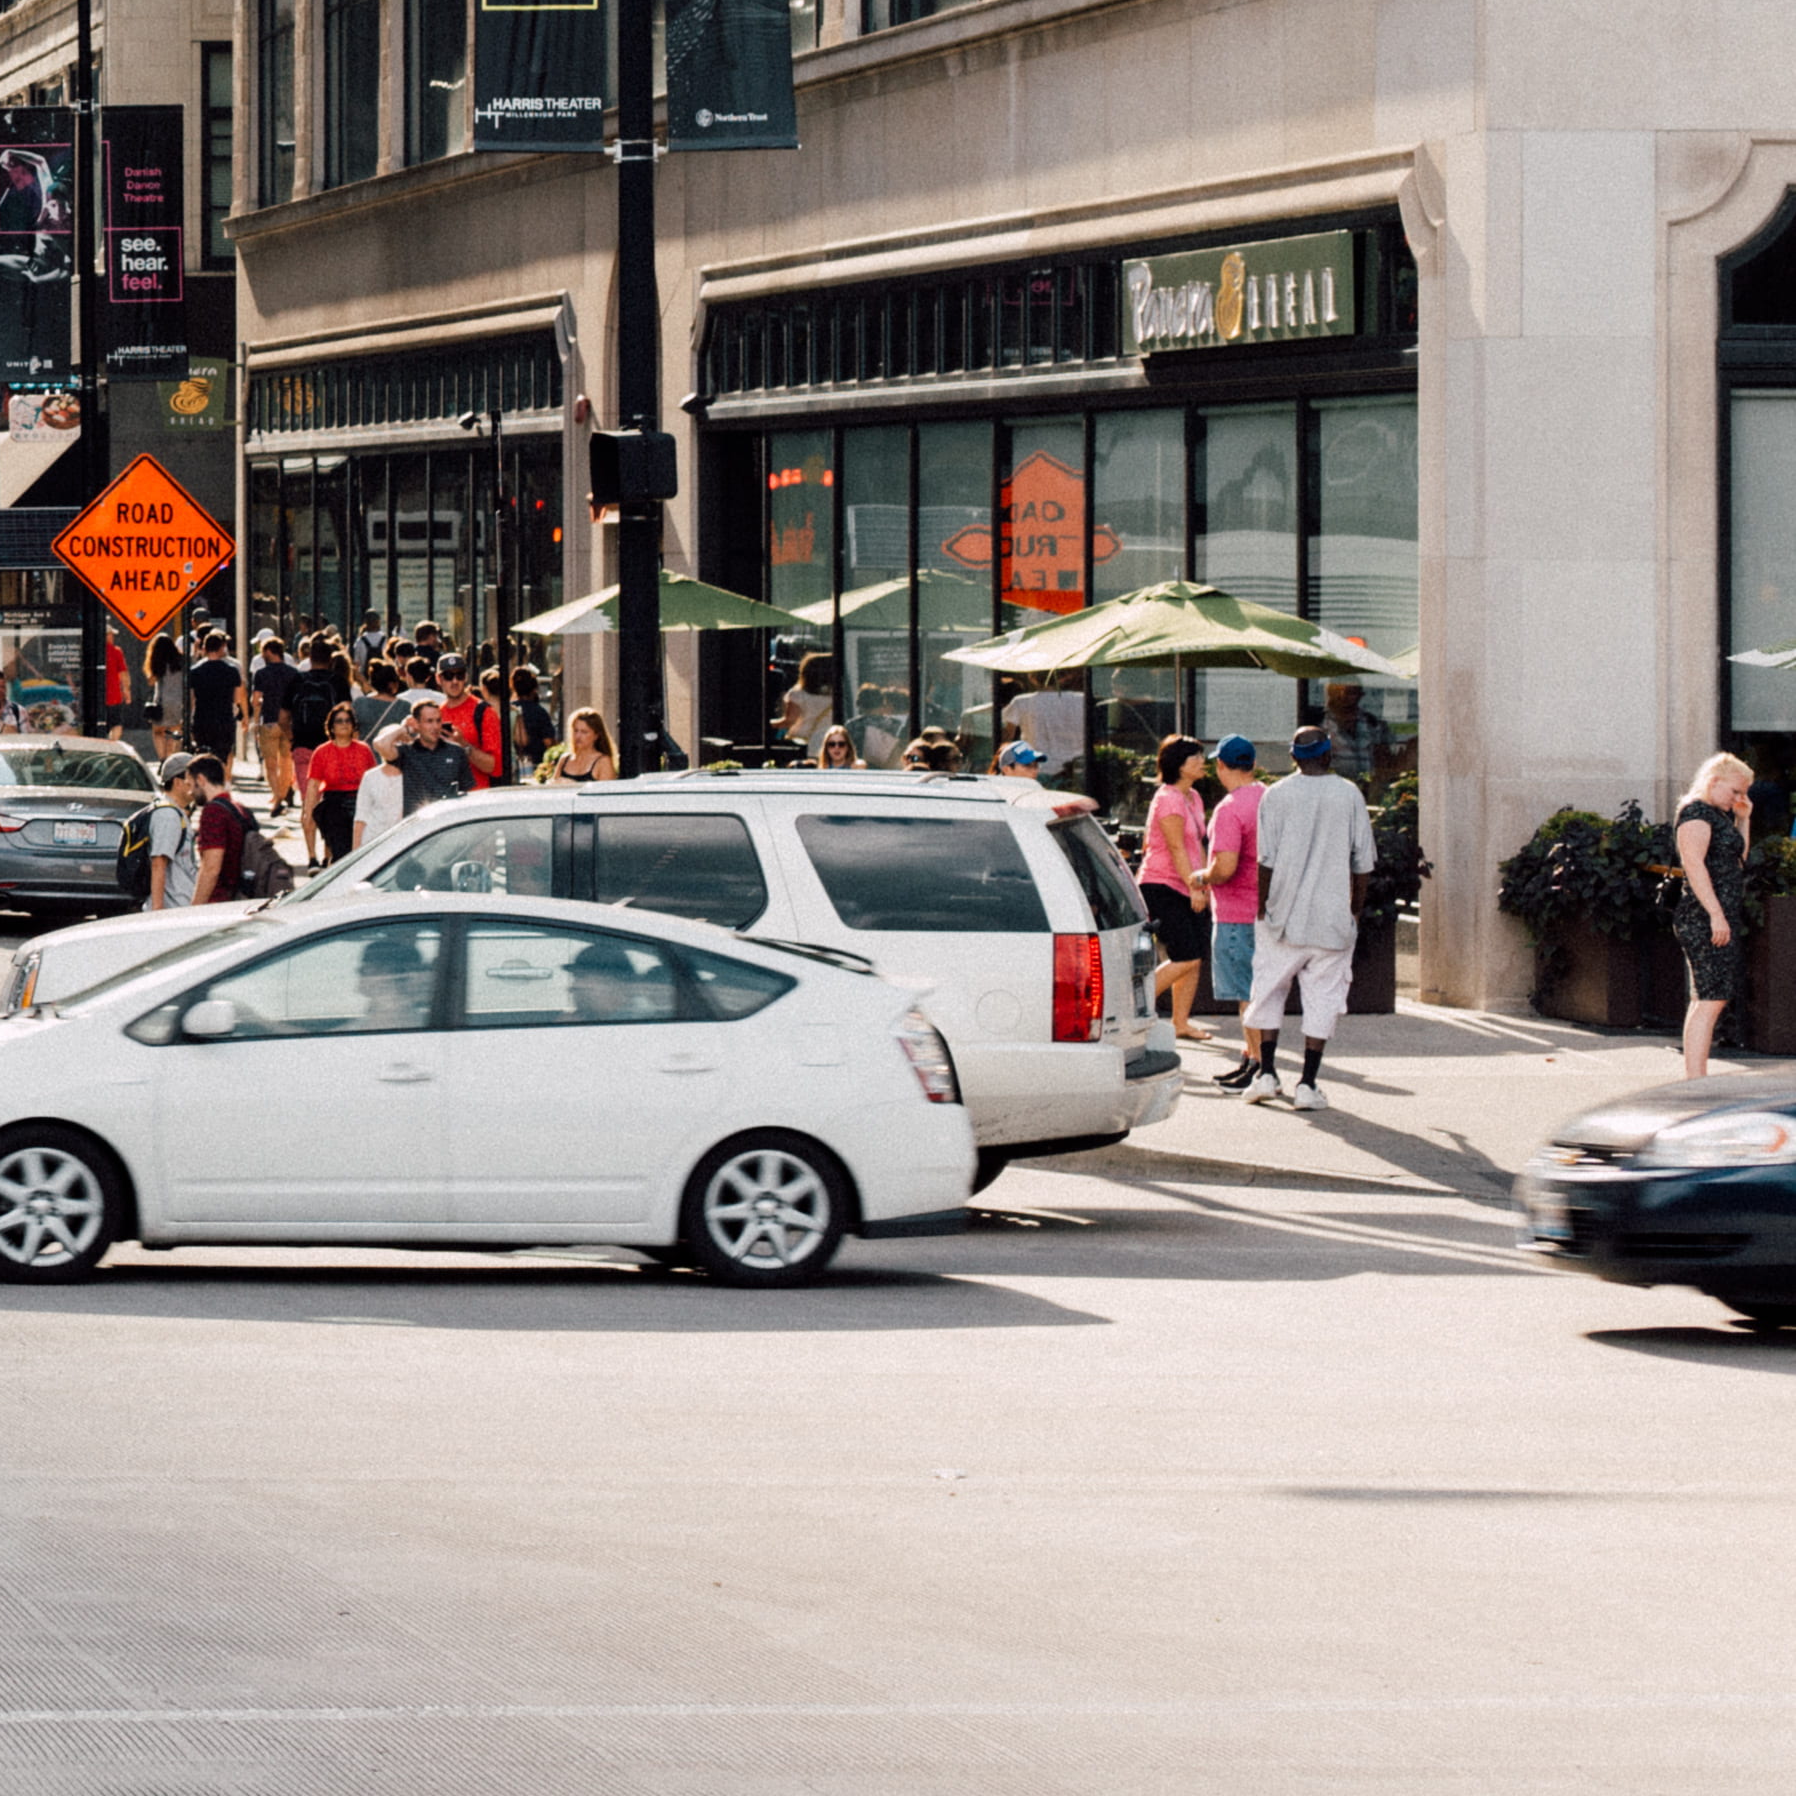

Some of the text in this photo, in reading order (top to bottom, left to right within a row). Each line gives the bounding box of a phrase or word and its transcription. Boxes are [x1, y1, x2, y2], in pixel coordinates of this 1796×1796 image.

[492, 98, 601, 111] HARRIS THEATER
[124, 167, 162, 177] Danish
[126, 181, 161, 190] Dance
[123, 193, 164, 203] Theatre
[121, 237, 161, 252] see.
[121, 254, 169, 271] hear.
[122, 273, 163, 290] feel.
[1128, 262, 1215, 344] Panera
[118, 345, 187, 355] HARRIS THEATER
[117, 503, 174, 524] ROAD
[69, 536, 221, 558] CONSTRUCTION
[110, 570, 180, 591] AHEAD
